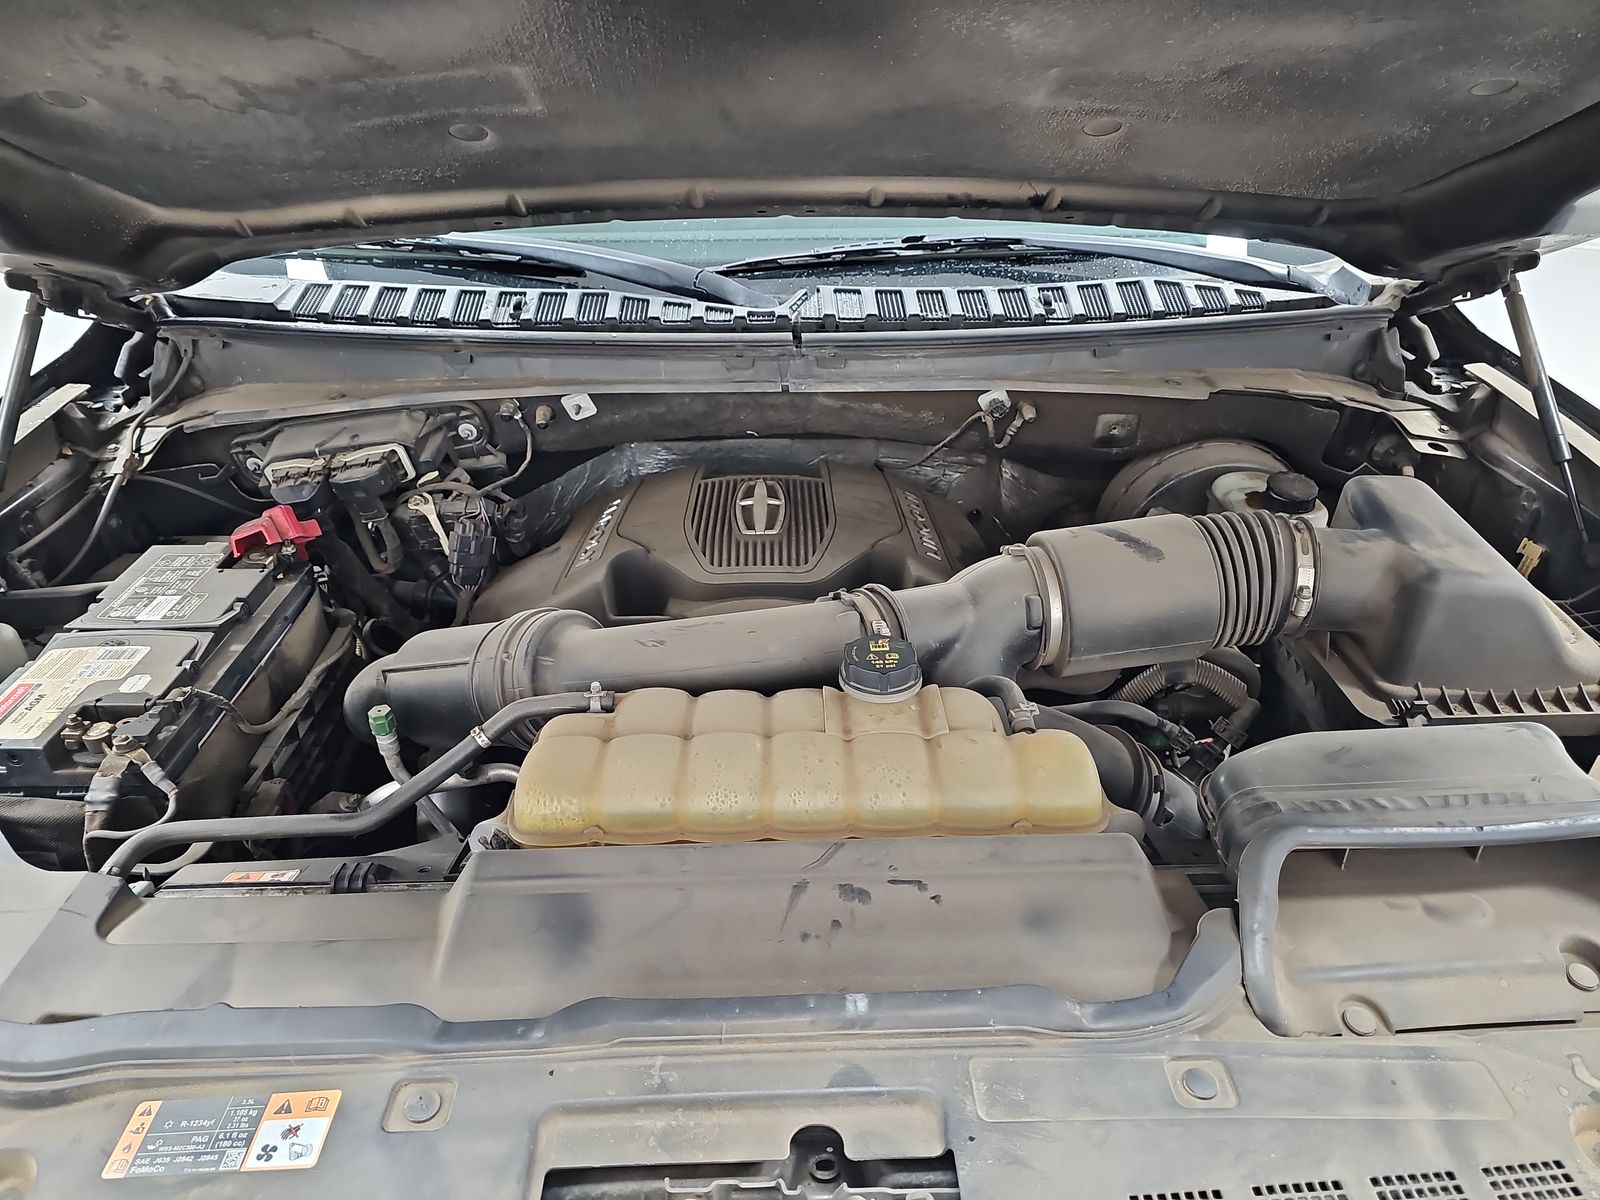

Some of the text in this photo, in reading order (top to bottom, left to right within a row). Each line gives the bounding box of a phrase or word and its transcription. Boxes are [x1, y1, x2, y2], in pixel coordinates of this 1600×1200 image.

[24, 694, 47, 711] AGM
[230, 1109, 258, 1117] 1.105 kg
[180, 1118, 216, 1128] R-1234yf
[190, 1135, 209, 1143] PAG
[214, 1139, 246, 1149] (180 cc)
[134, 1157, 151, 1165] SAE
[129, 1165, 165, 1174] FoMoCo
